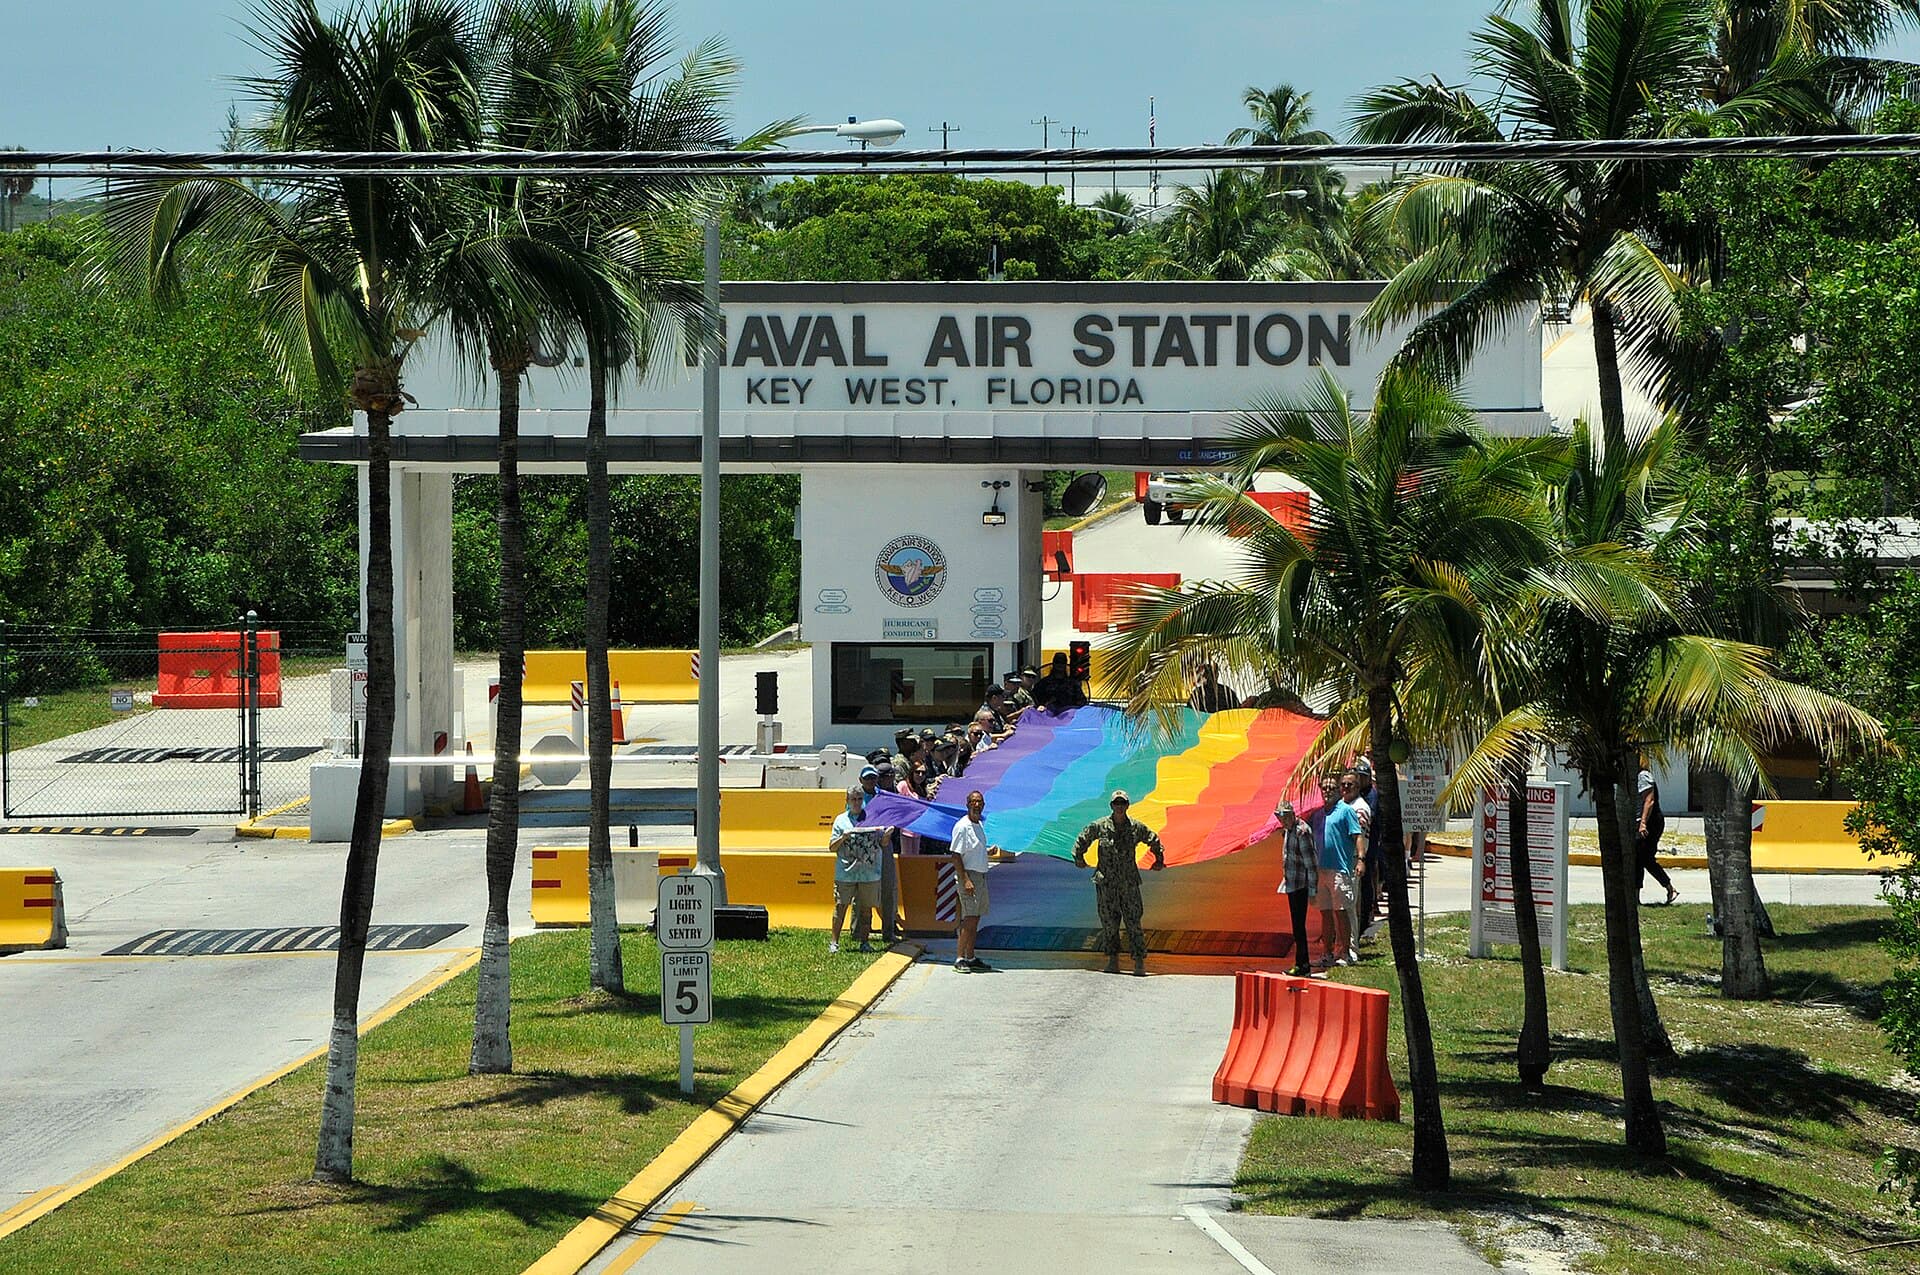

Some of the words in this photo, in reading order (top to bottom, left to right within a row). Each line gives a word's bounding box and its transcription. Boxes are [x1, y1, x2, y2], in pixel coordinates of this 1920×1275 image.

[924, 316, 1032, 367] AIR
[1073, 314, 1351, 367] STATION
[747, 378, 812, 405] KEY
[987, 378, 1144, 405] FLORIDA
[881, 545, 900, 564] NAVAL
[902, 539, 915, 547] AIR
[917, 540, 942, 565] STATION
[886, 587, 904, 602] KEY
[918, 583, 940, 602] WEST
[927, 630, 933, 638] 5
[676, 885, 695, 896] DIM
[669, 899, 702, 910] LIGHTS
[676, 914, 695, 925] FOR
[669, 928, 702, 940] SENTRY
[668, 956, 704, 965] SPEED
[673, 967, 700, 976] LIMIT
[675, 980, 699, 1015] 5
